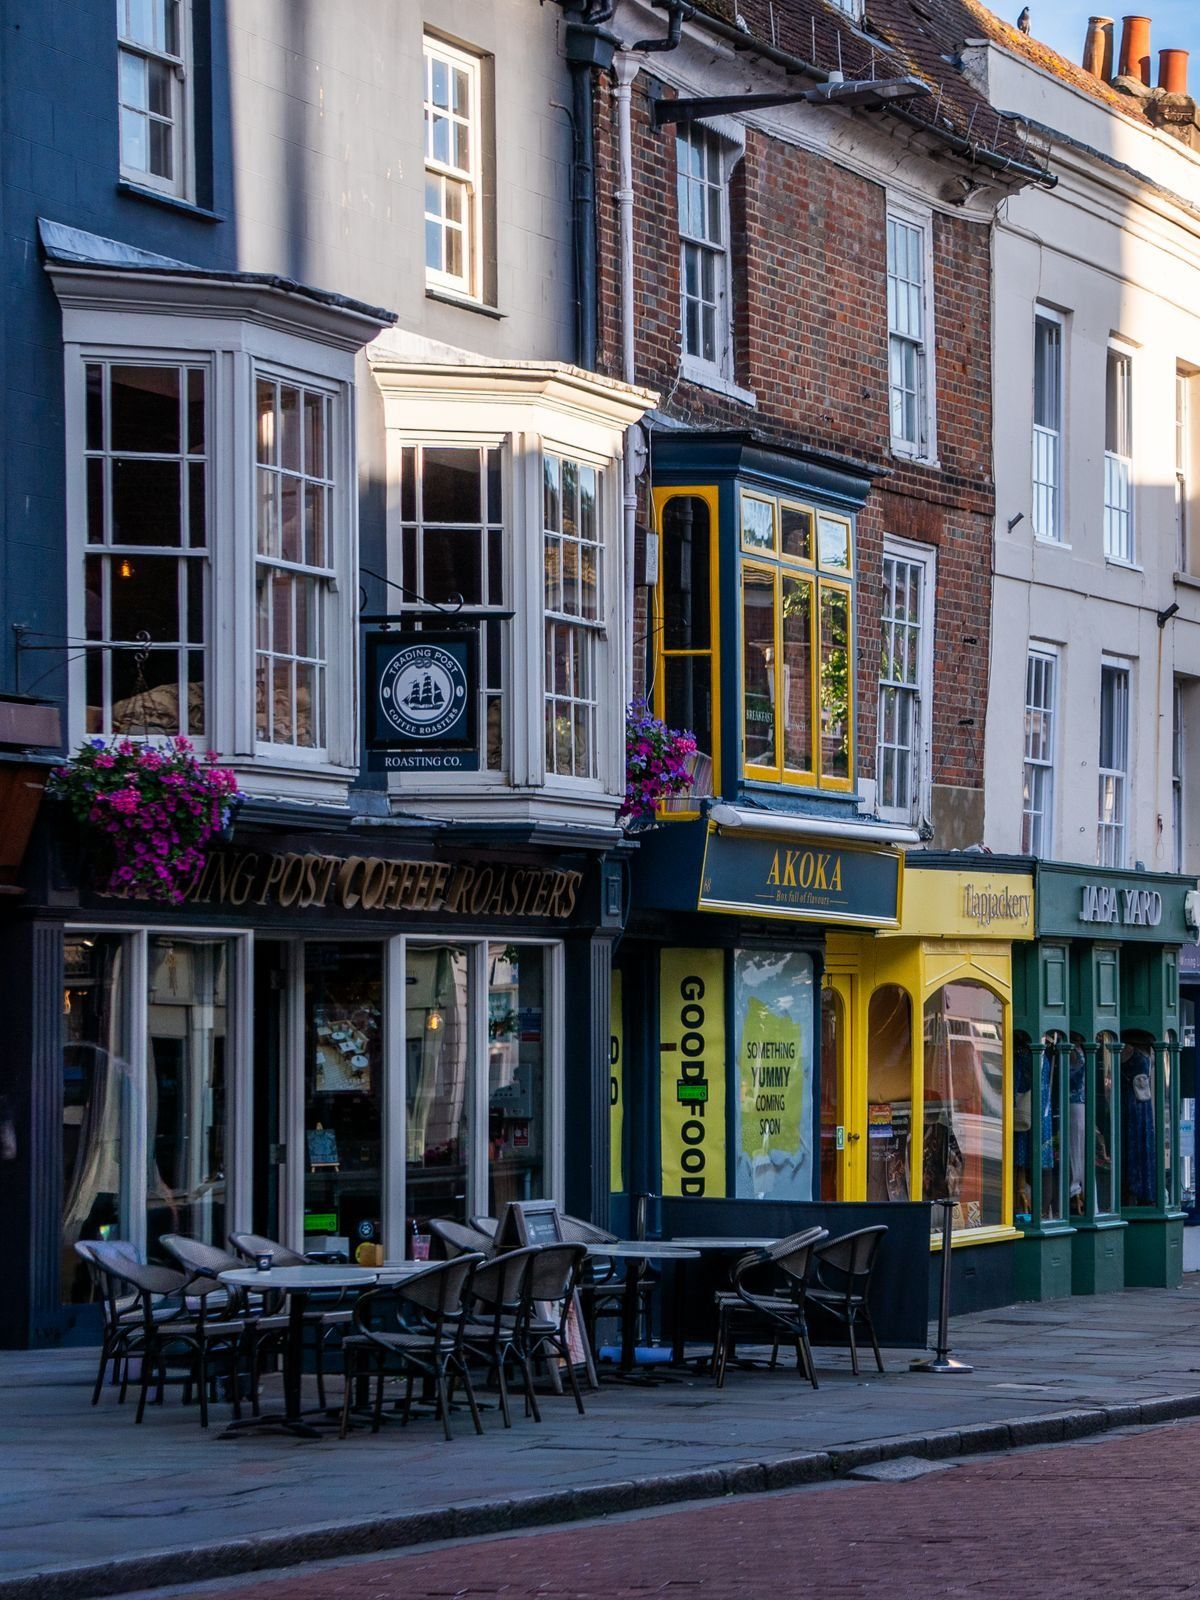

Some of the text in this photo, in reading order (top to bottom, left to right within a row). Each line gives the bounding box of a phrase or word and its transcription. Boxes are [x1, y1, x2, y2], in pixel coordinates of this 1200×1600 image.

[388, 649, 459, 675] TRADING POST
[389, 707, 458, 734] COFFEE ROASTERS
[385, 756, 462, 767] ROASTING CO.
[257, 852, 343, 908] POST
[335, 855, 450, 911] COFFEE
[450, 864, 584, 918] ROASTERS
[766, 849, 843, 891] AKOKA
[776, 890, 787, 902] Box
[788, 891, 800, 903] full
[807, 892, 830, 905] flavours
[964, 884, 1031, 927] flapjackery
[1079, 885, 1162, 926] JABA YARD
[680, 976, 705, 1081] GOOD
[751, 1066, 791, 1088] YUMMY
[759, 1118, 781, 1135] SOON
[680, 1100, 705, 1198] FOOD
